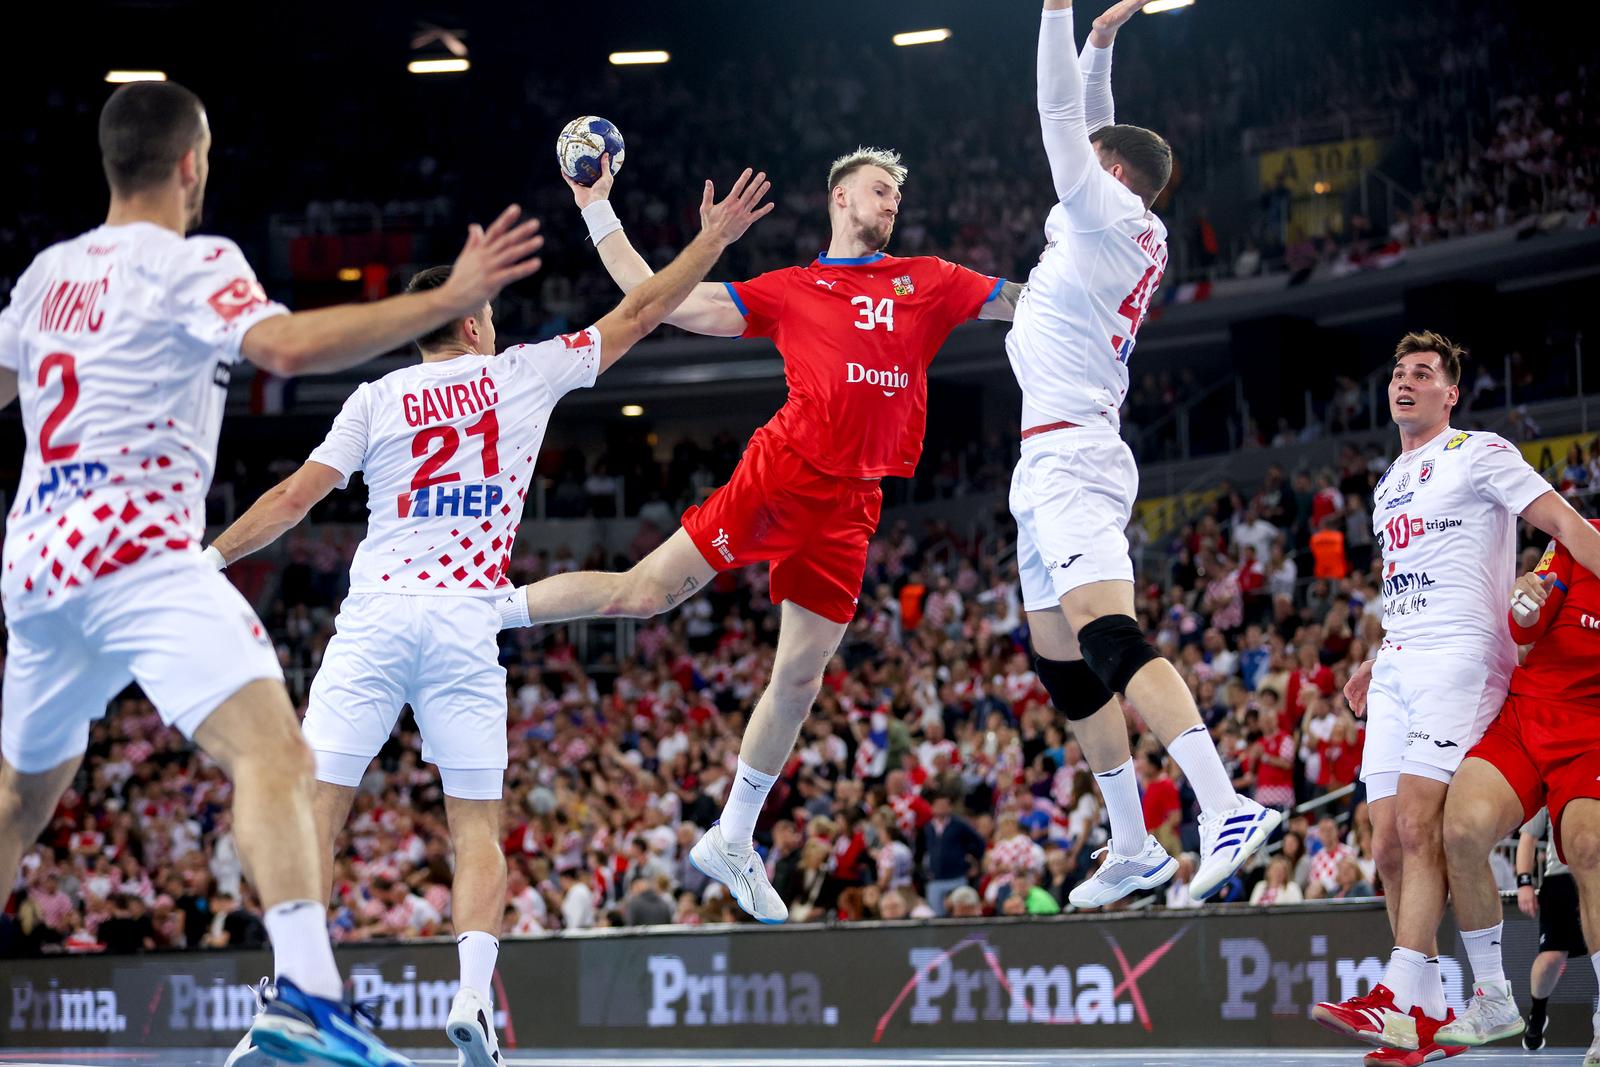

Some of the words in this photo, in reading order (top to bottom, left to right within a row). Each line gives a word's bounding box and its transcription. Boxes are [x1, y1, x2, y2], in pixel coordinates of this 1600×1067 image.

[851, 295, 894, 331] 34
[403, 367, 499, 427] GAVRIĆ
[846, 362, 909, 389] Donio
[38, 352, 80, 464] 2
[410, 408, 500, 491] 21
[435, 484, 503, 517] HEP
[1425, 517, 1463, 533] triglav
[1385, 513, 1410, 552] 10
[647, 953, 838, 1027] Prima.
[910, 946, 1133, 1025] Prima.
